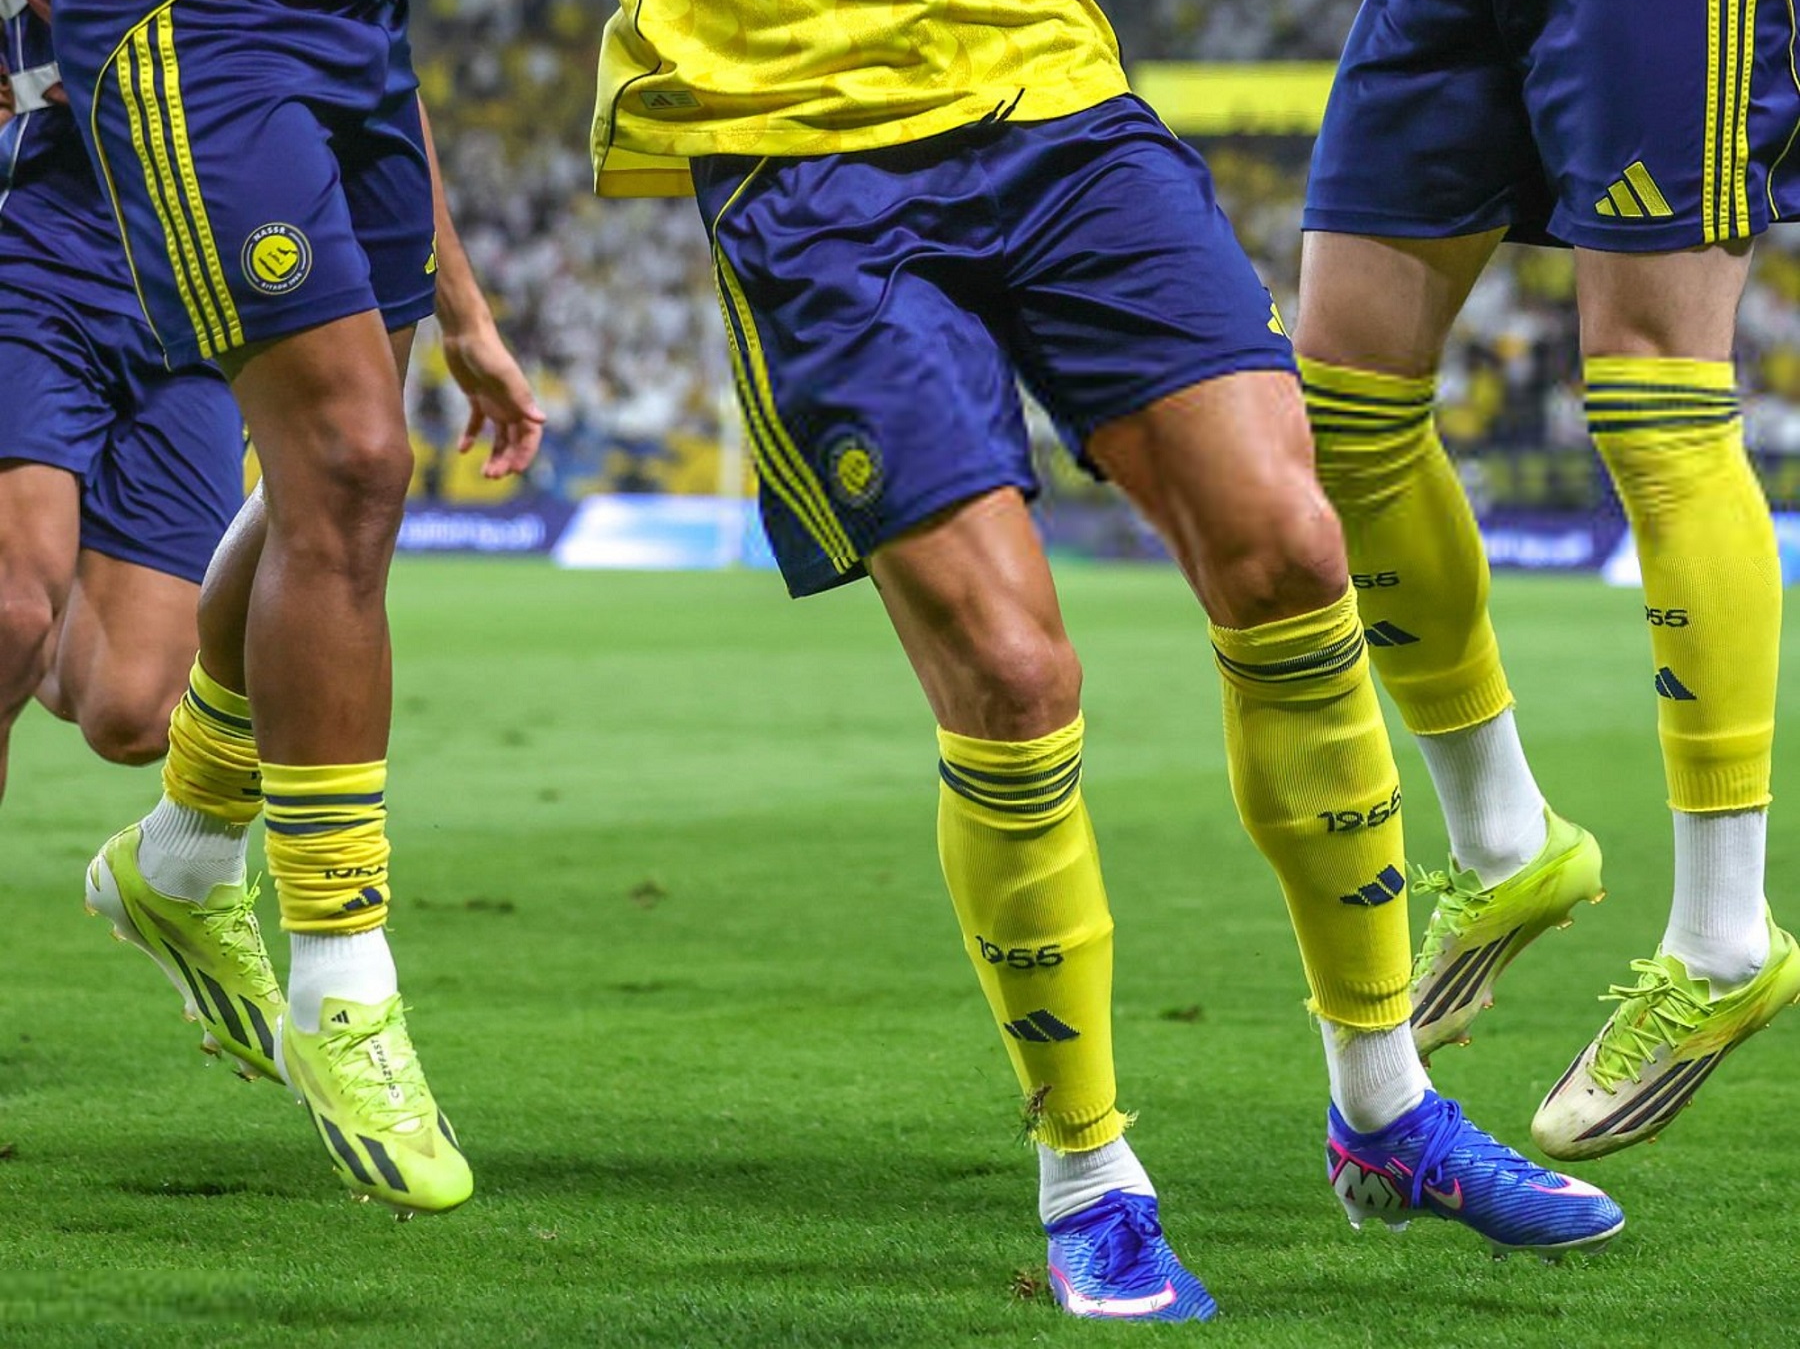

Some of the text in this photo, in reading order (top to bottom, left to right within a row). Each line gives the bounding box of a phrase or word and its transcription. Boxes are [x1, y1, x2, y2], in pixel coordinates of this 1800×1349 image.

[252, 226, 286, 242] NASSR
[1317, 784, 1402, 832] 1955
[975, 935, 1064, 970] 1955
